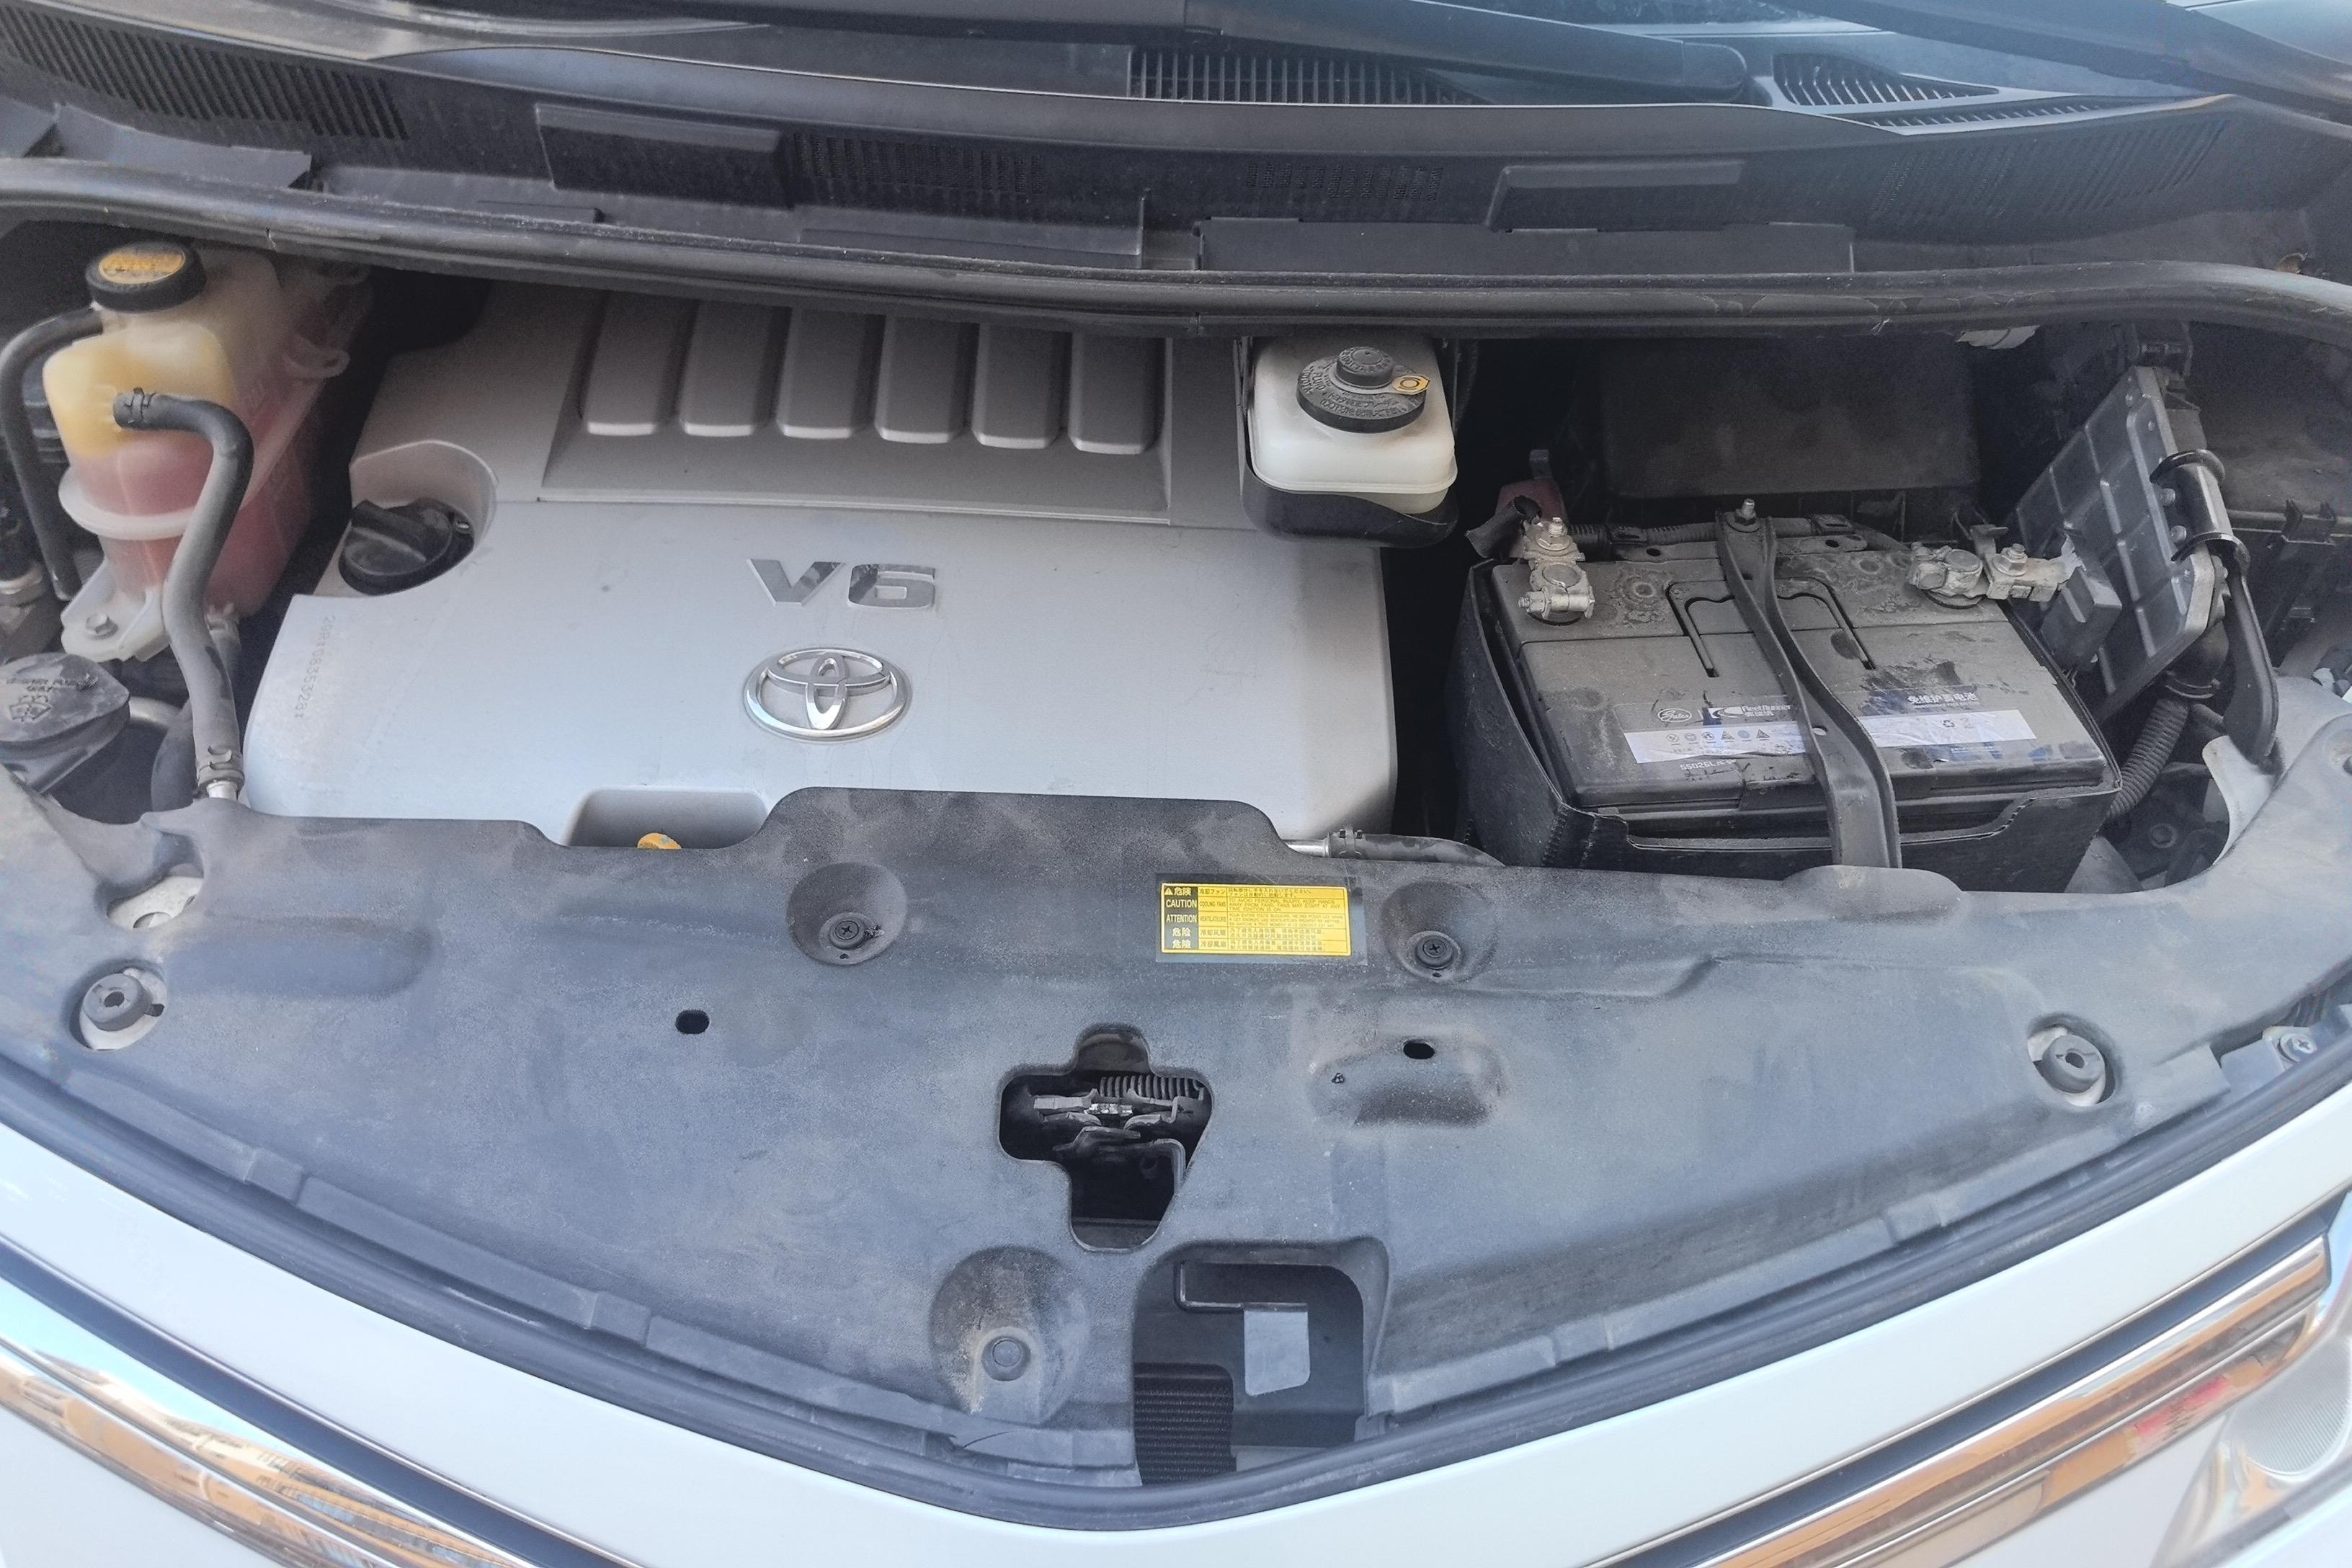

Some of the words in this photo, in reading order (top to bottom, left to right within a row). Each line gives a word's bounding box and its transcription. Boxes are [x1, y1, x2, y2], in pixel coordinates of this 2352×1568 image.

[747, 558, 937, 610] V6
[1907, 692, 1977, 704] 免维护蓄电池
[1660, 710, 1690, 721] Gates
[1680, 761, 1716, 770] 55D26L
[1166, 899, 1197, 908] CAUTION
[1166, 914, 1197, 923] ATTENTION
[1172, 927, 1191, 937] 危险
[1172, 940, 1191, 949] 危險
